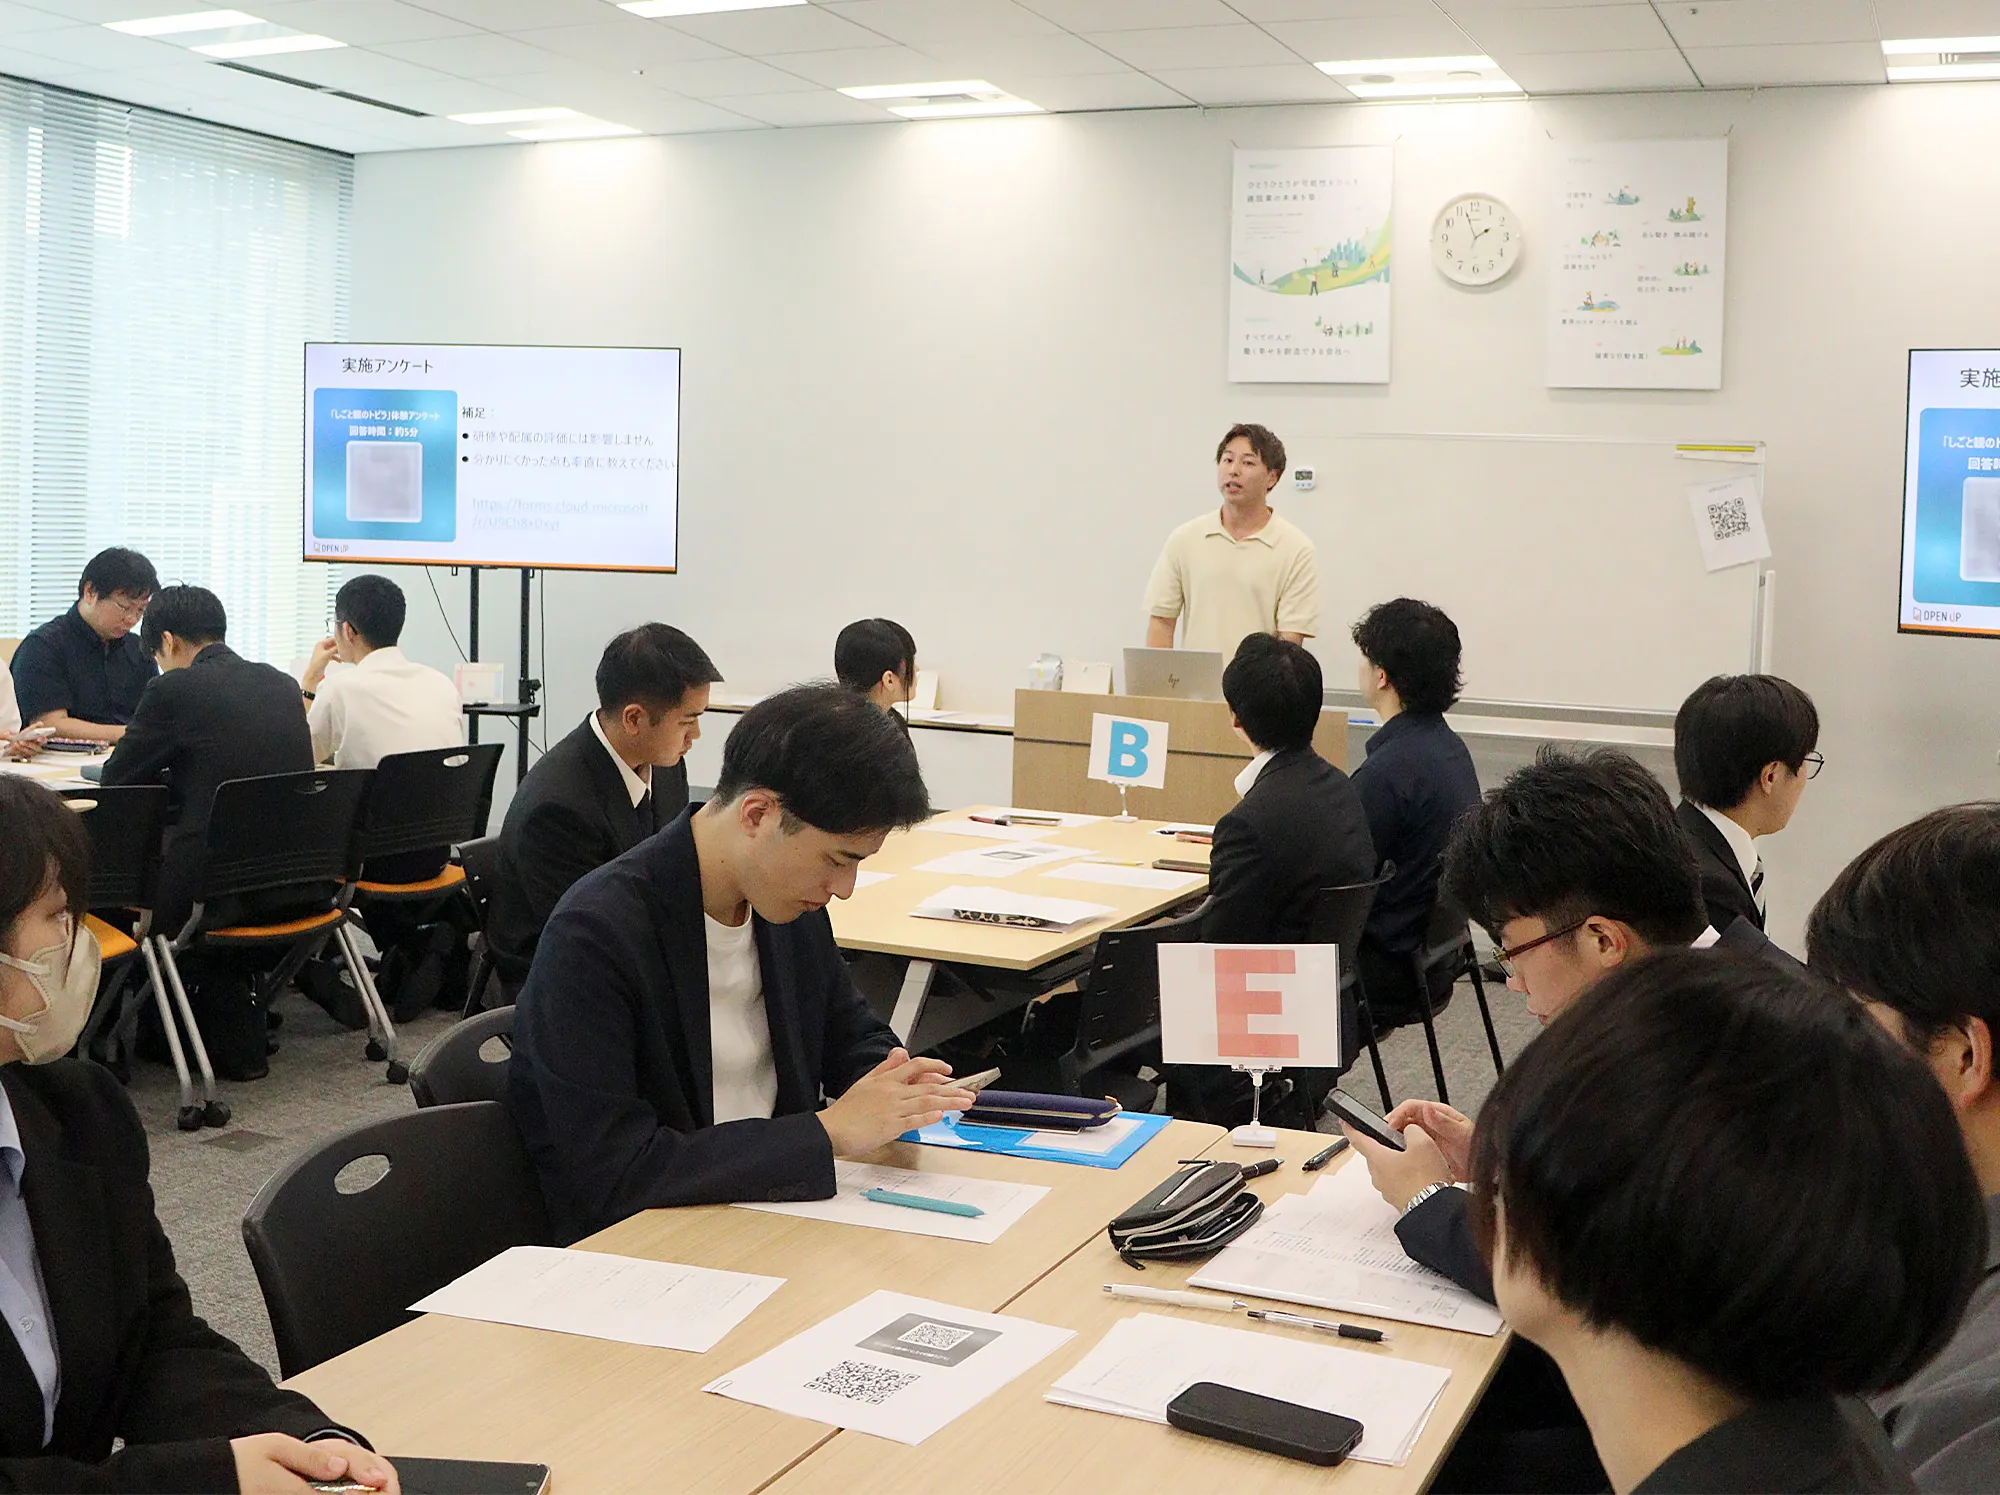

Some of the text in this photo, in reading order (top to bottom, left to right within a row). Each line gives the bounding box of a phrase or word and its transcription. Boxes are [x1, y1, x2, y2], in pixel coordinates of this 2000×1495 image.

[1456, 206, 1463, 217] 11
[1470, 201, 1480, 212] 12
[1488, 205, 1492, 216] 1
[1445, 217, 1454, 228] 10
[1499, 216, 1505, 227] 2
[1441, 233, 1449, 243] 9
[1503, 232, 1510, 243] 3
[1446, 249, 1453, 259] 8
[1497, 247, 1504, 258] 4
[1457, 260, 1463, 271] 7
[1472, 265, 1480, 275] 6
[1488, 260, 1495, 271] 5
[342, 357, 434, 374] 実施アンケート
[321, 544, 340, 553] OPEN
[1924, 610, 1962, 623] OPEN UP
[1107, 720, 1149, 778] B
[1214, 949, 1299, 1059] E
